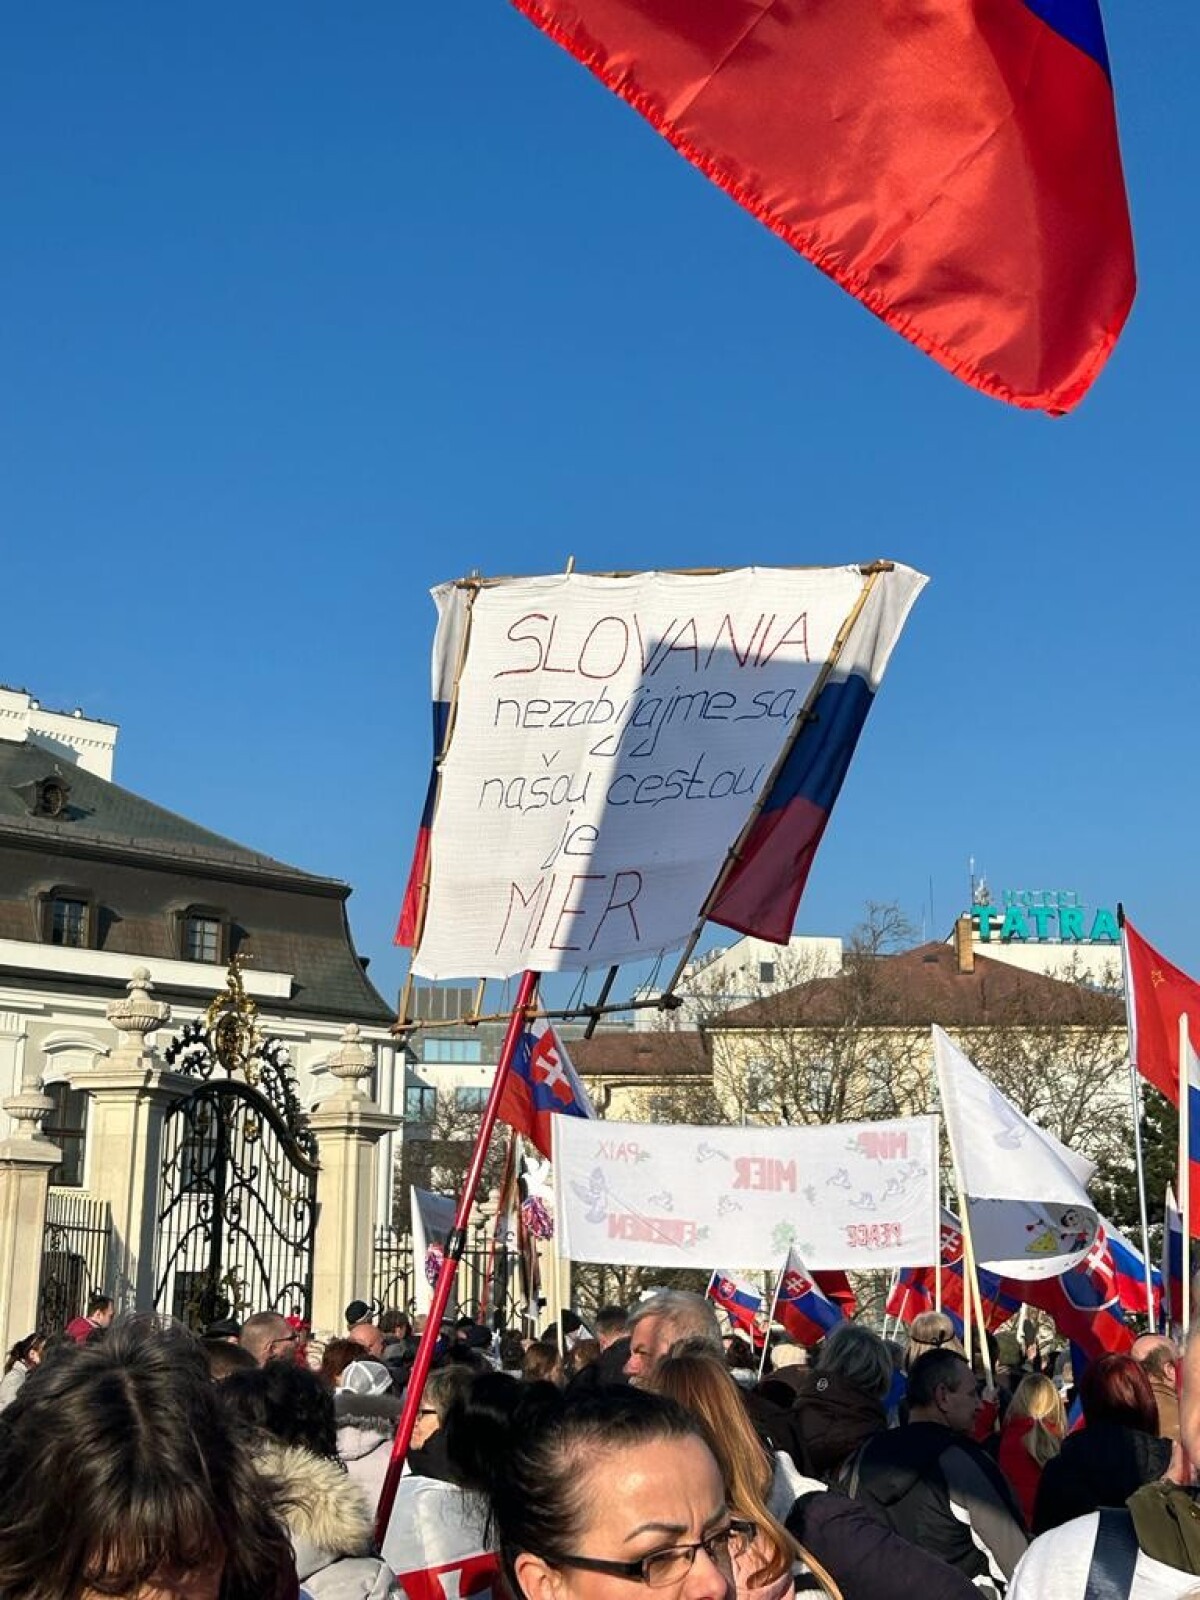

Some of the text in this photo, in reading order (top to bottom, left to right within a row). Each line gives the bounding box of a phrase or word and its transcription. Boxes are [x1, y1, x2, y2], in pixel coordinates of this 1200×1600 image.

[494, 612, 810, 679] SLOVANIA
[494, 685, 796, 757] nezabíjajme sa,
[478, 750, 765, 815] našou cestou
[541, 809, 599, 870] je
[495, 870, 643, 956] MIER
[970, 905, 1121, 941] TATRA
